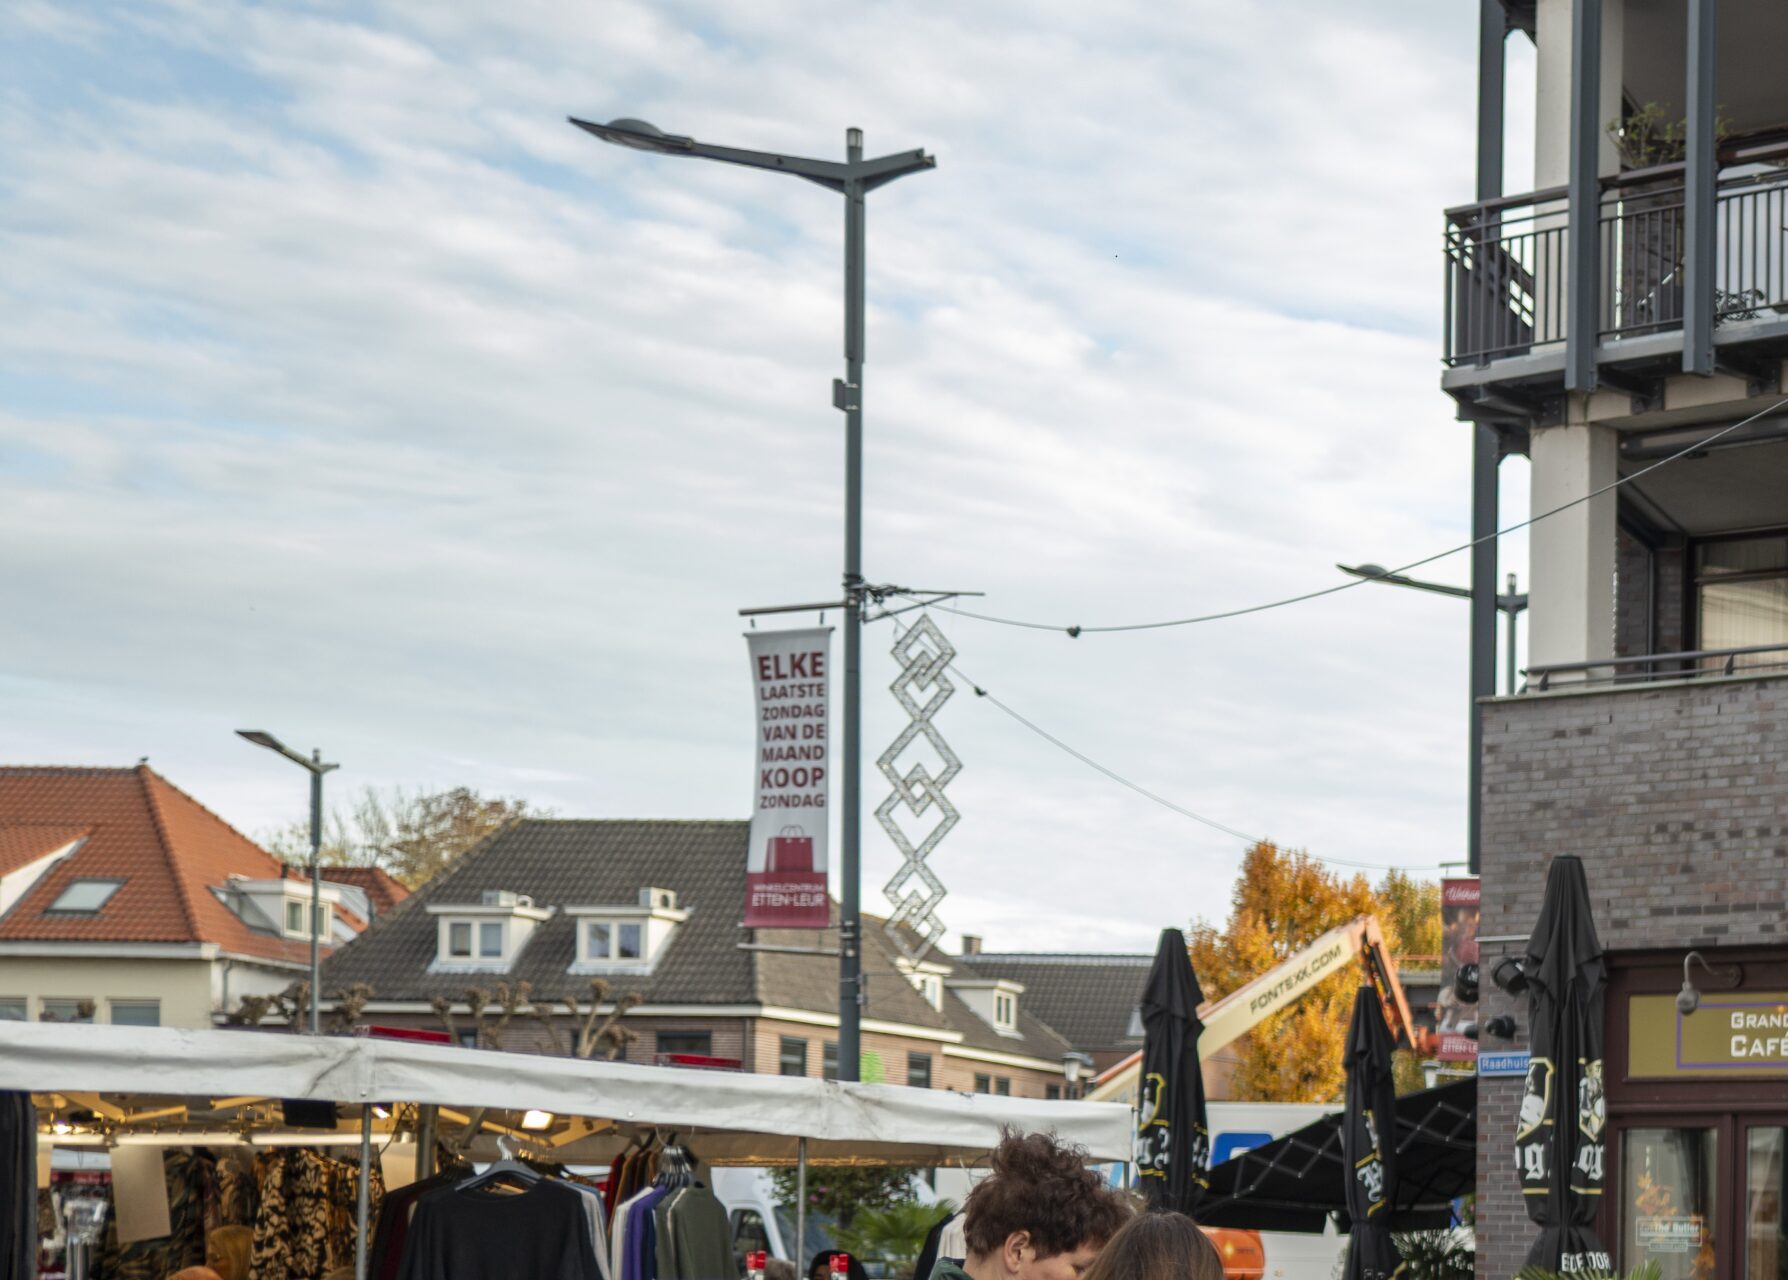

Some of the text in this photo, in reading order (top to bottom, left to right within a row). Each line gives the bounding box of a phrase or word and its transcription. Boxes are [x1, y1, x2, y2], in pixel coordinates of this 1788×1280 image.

[757, 652, 824, 681] ELKE
[760, 683, 825, 700] LAATSTE
[762, 704, 825, 721] ZONDAG
[763, 723, 825, 741] VAN DE
[762, 745, 825, 762] MAAND
[761, 767, 825, 789] KOOP
[760, 794, 825, 809] ZONDAG
[752, 893, 825, 907] ETTEN-LEUR
